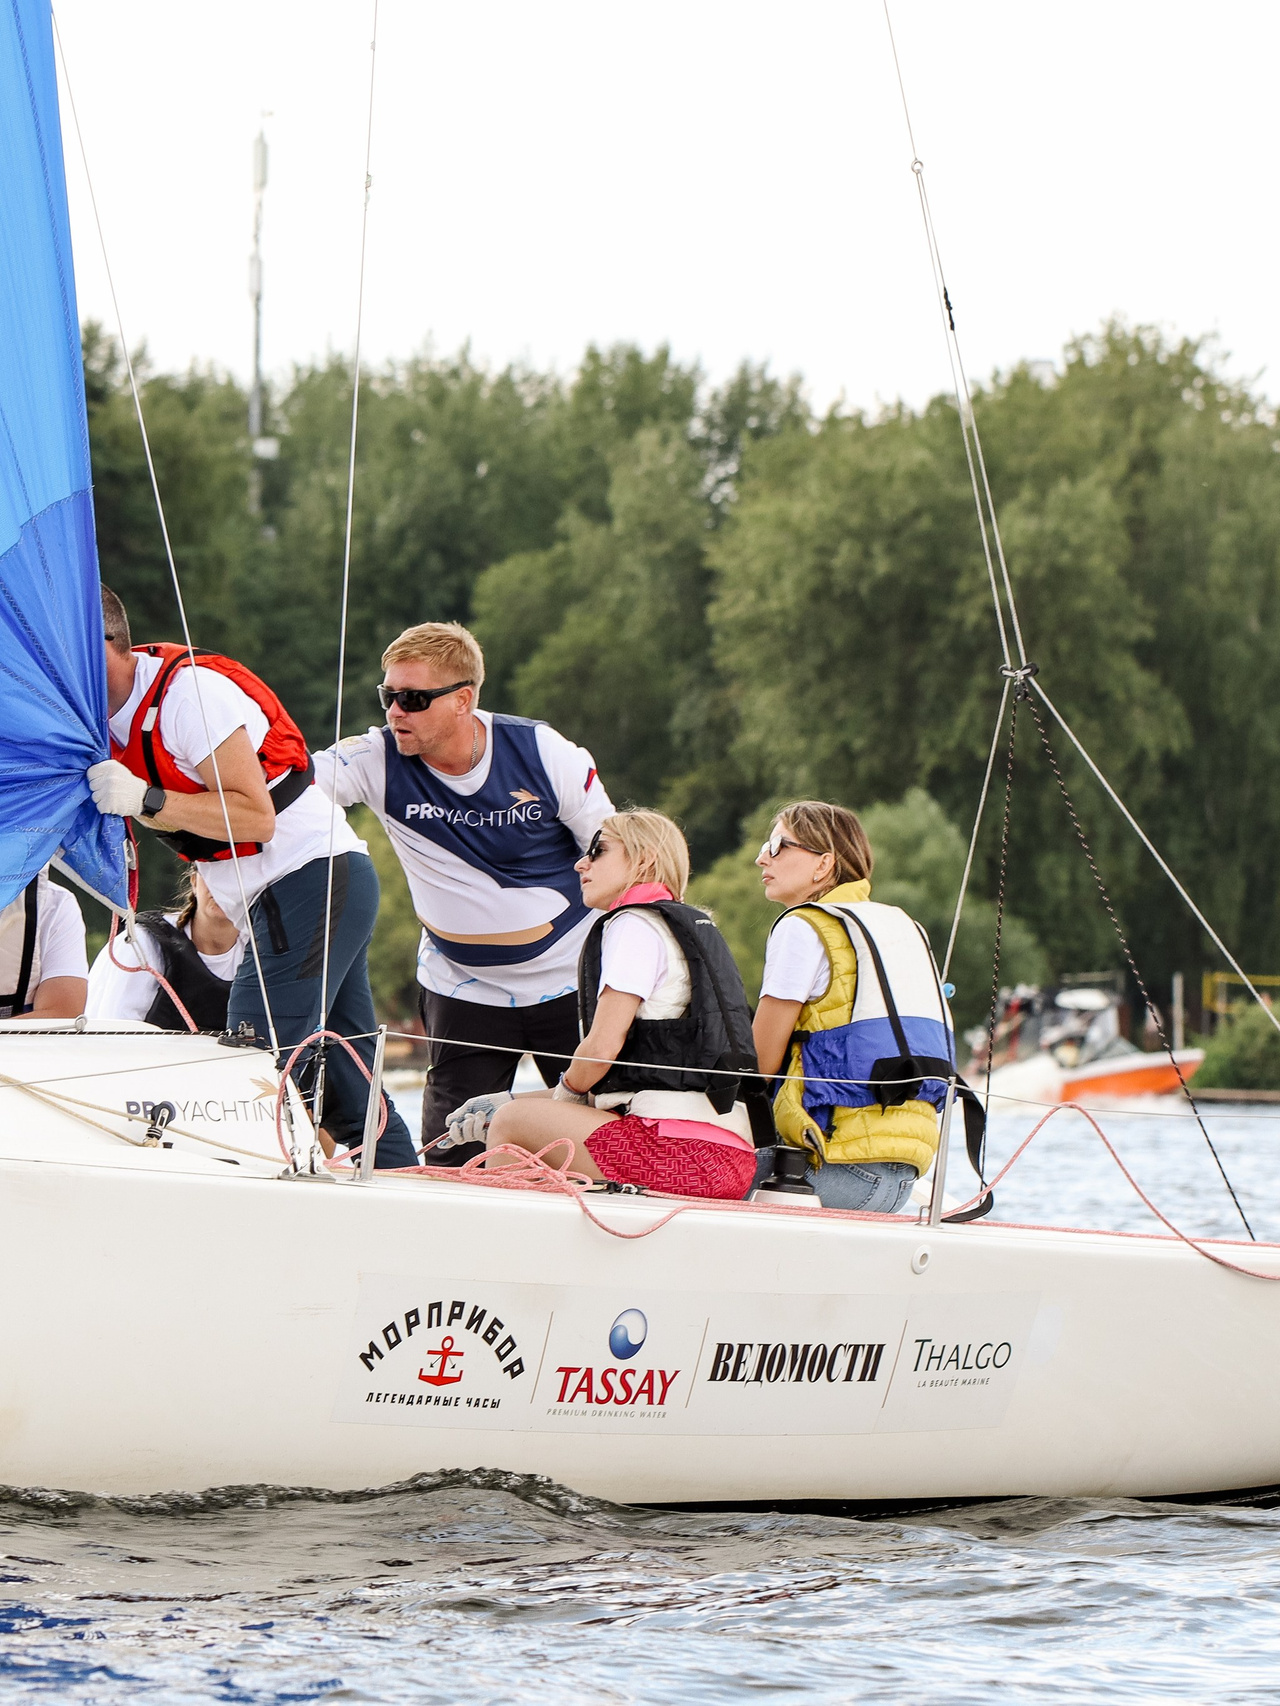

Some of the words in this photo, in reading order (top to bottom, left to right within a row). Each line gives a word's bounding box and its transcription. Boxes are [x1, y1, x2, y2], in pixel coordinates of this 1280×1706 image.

[404, 802, 542, 827] PROYACHTING
[358, 1300, 526, 1380] МОРПРИБОР
[707, 1342, 887, 1387] ВЕДОМОСТИ
[555, 1366, 682, 1406] TASSAY
[917, 1380, 927, 1388] LA
[961, 1377, 990, 1386] MARINE
[366, 1391, 461, 1407] ЛЕГЕНДАРНЫЕ
[466, 1398, 501, 1409] ЧАСЫ
[546, 1408, 588, 1417] PREMIUM
[591, 1410, 636, 1418] DRINKING
[639, 1411, 667, 1419] WATER
